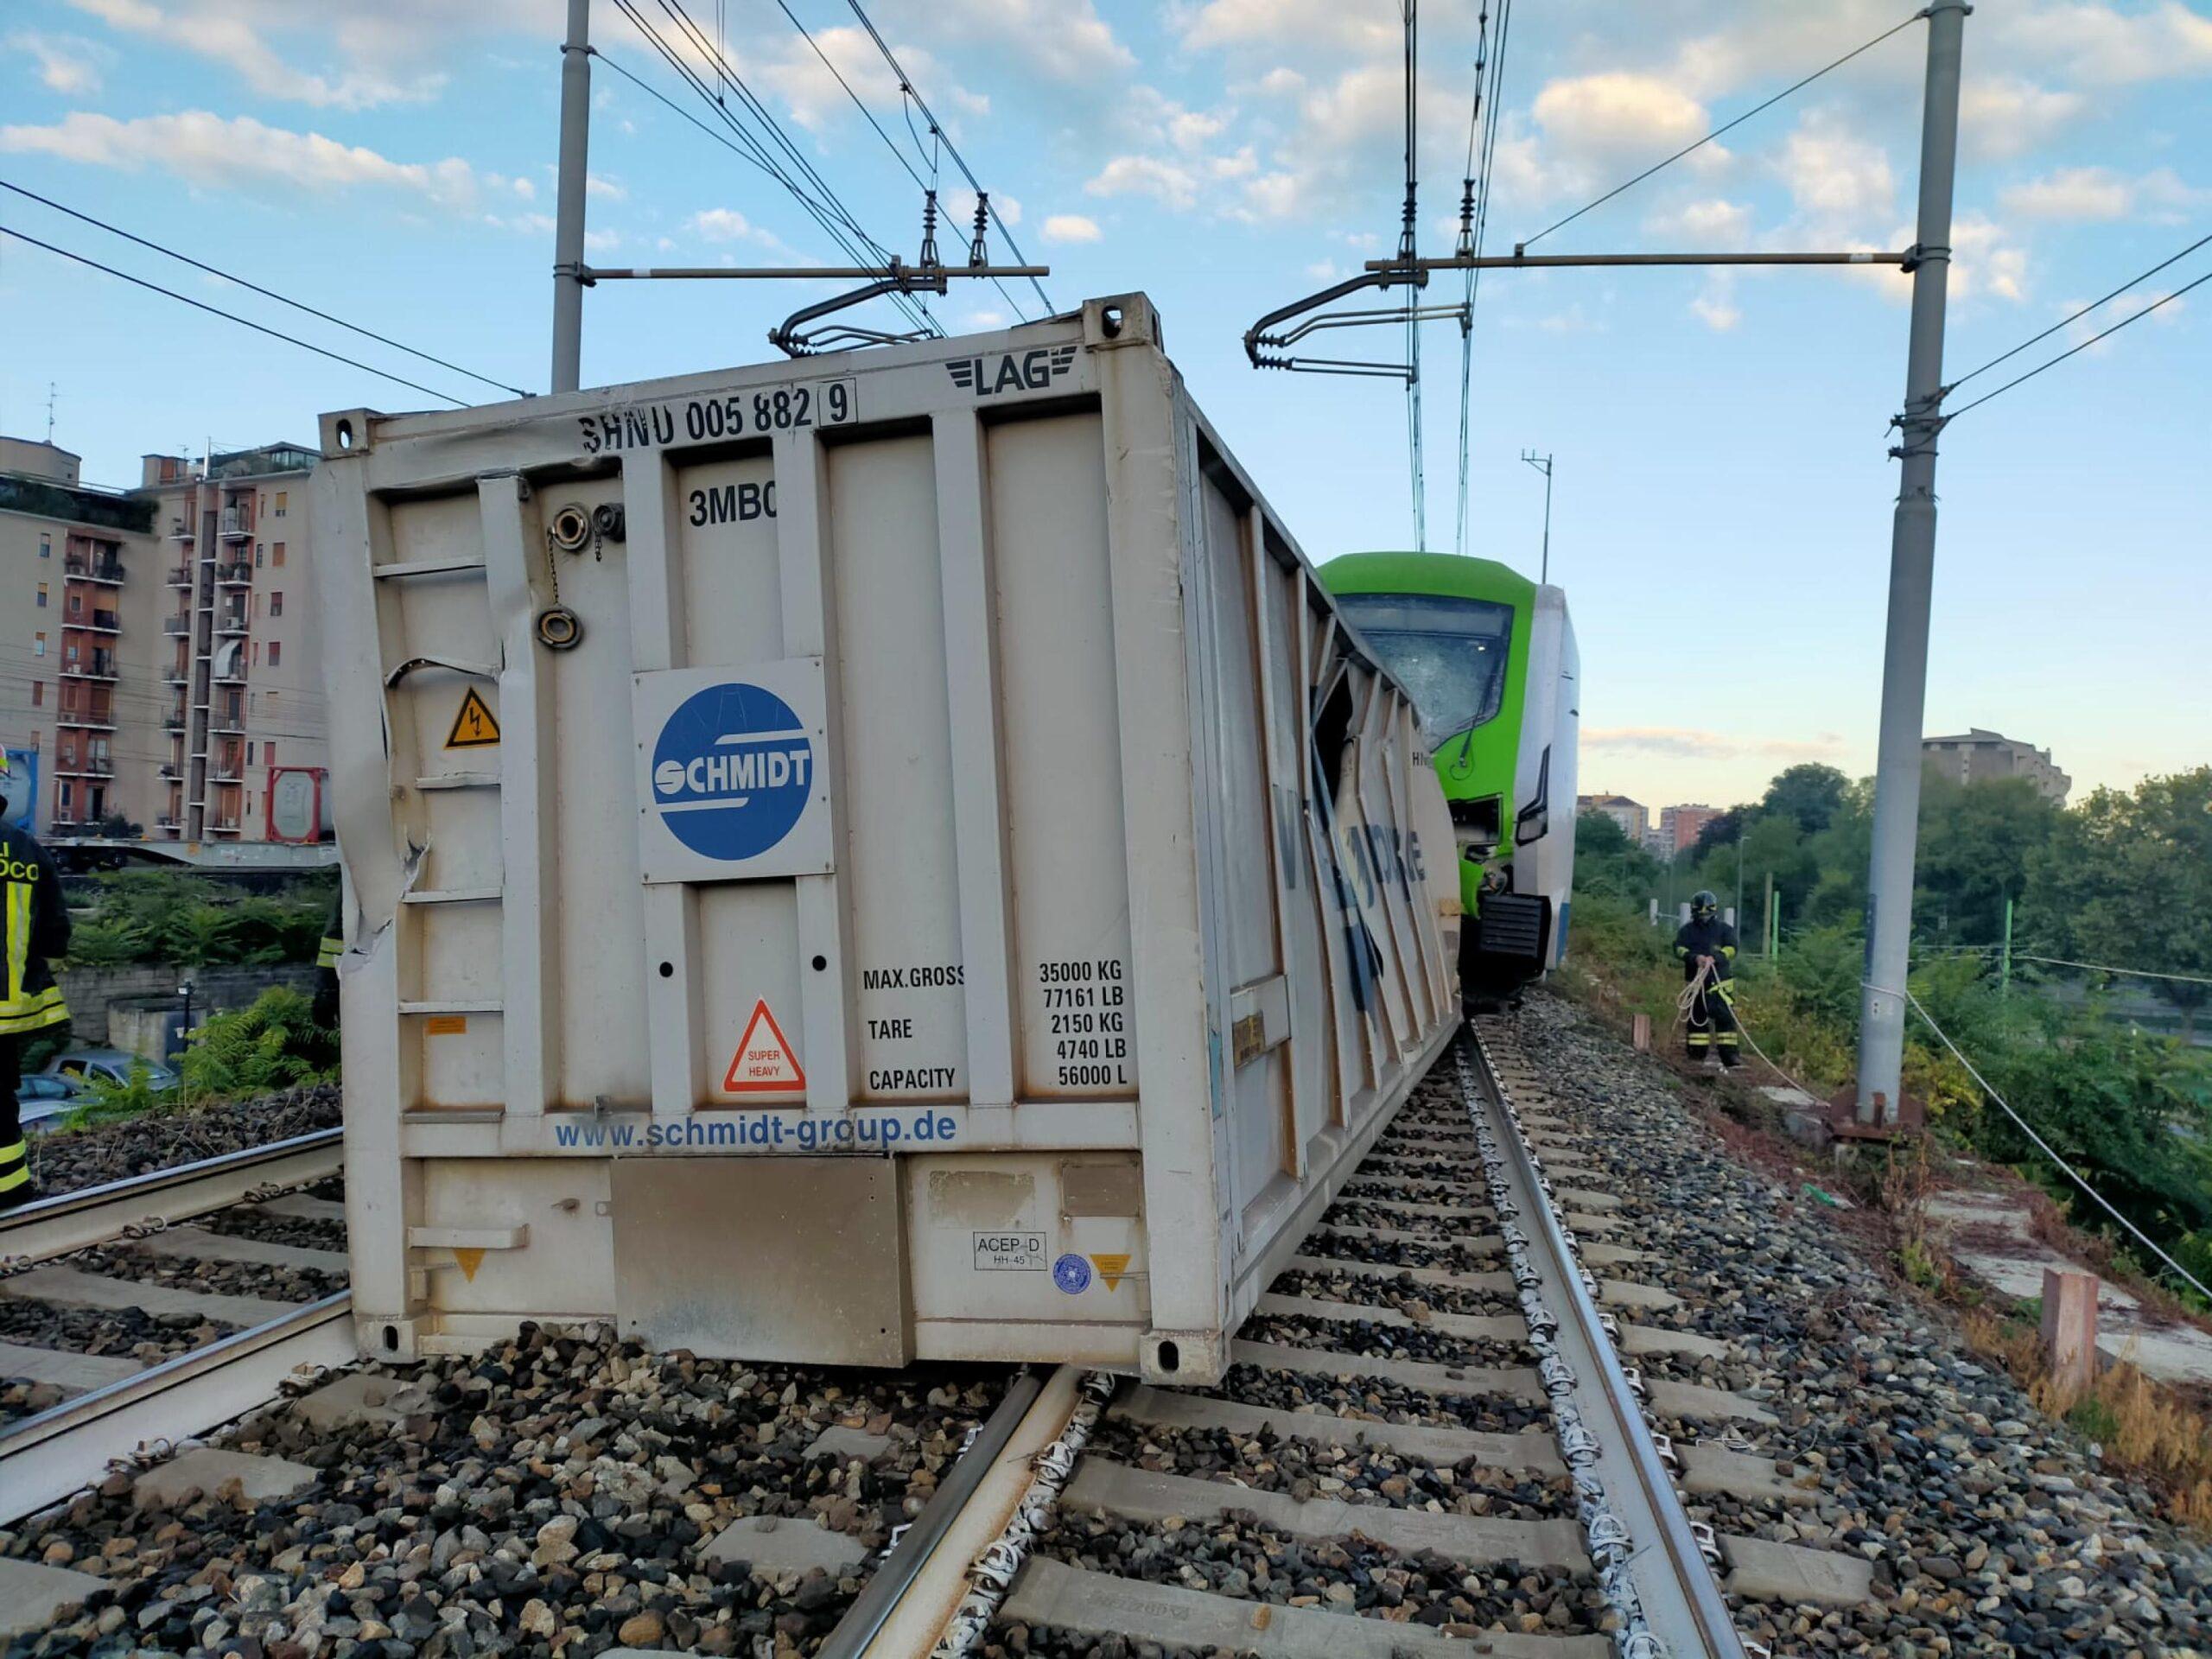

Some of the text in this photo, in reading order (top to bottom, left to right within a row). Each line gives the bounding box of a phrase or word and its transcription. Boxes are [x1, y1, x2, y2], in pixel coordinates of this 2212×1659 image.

[974, 349, 1051, 396] LAG
[577, 383, 849, 454] SHNU 005 882 9
[654, 748, 811, 795] SCHMIDT
[863, 959, 1122, 990] MAX.GROSS 35000 KG
[1043, 985, 1124, 1008] 77161 LB
[868, 1012, 1123, 1039] TARE 2150 KG
[747, 1050, 781, 1061] SUPER
[1057, 1038, 1127, 1060] 4740 LB
[748, 1065, 780, 1077] HEAVY
[869, 1065, 1128, 1090] CAPACITY 56000 L
[555, 1109, 957, 1150] www.schmidt-group.de
[977, 1237, 1020, 1252] ACEP
